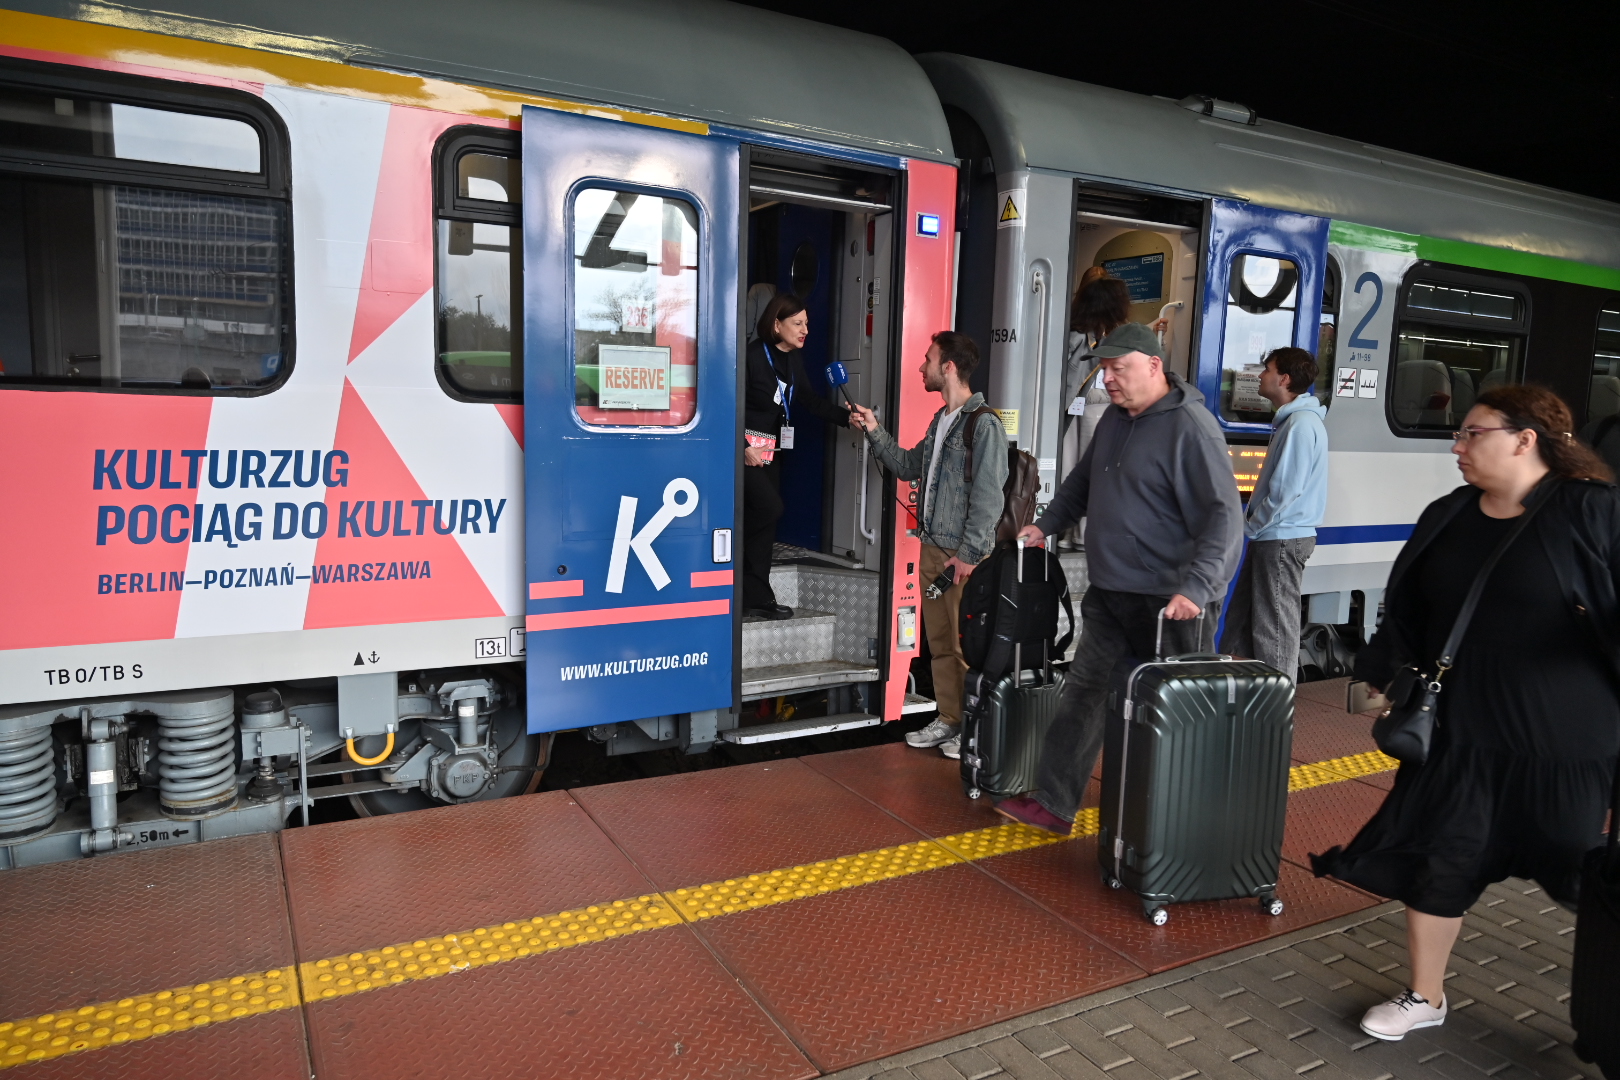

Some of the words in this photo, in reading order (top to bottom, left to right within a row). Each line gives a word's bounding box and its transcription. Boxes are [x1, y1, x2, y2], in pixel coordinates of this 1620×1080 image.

[1347, 272, 1383, 349] 2
[605, 366, 665, 390] RESERVE
[93, 449, 350, 490] KULTURZUG
[96, 502, 262, 548] POCIĄG
[272, 502, 329, 539] DO
[337, 498, 507, 537] KULTURY
[605, 478, 699, 594] K
[479, 640, 503, 656] 13t
[560, 651, 709, 682] WWW.KULTURZUG.ORG
